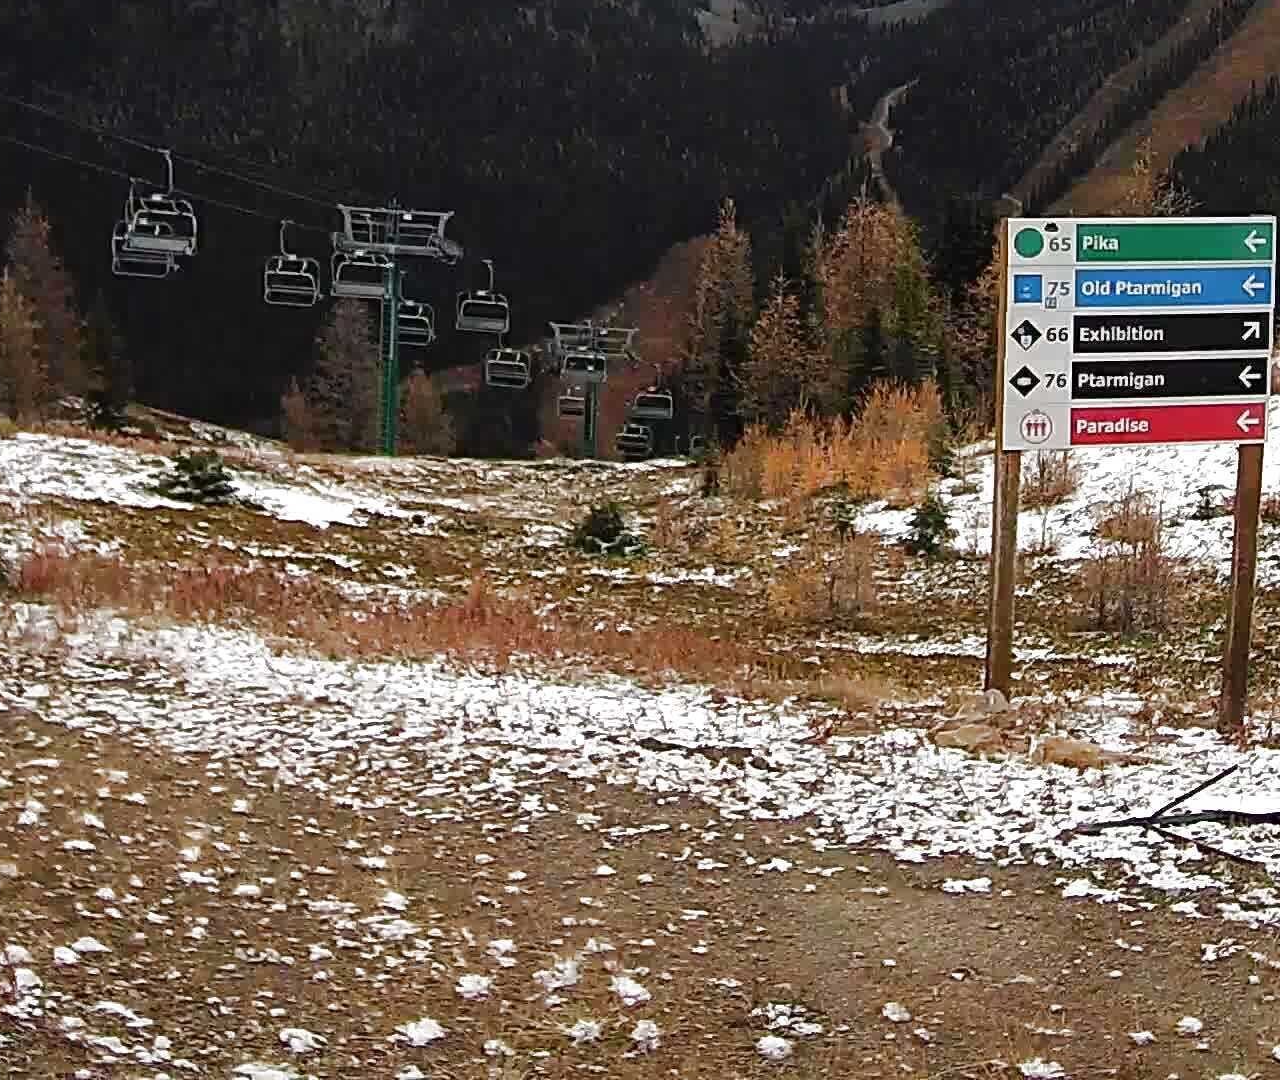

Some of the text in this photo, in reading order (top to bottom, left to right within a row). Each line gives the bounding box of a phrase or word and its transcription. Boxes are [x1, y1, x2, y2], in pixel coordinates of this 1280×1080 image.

[1048, 234, 1119, 252] 65 Pika
[1047, 280, 1202, 298] 75 Old Ptarmigan
[1045, 325, 1164, 342] 66 Exhibition
[1044, 371, 1165, 389] 76 Ptarmigan
[1076, 417, 1149, 434] Paradise
